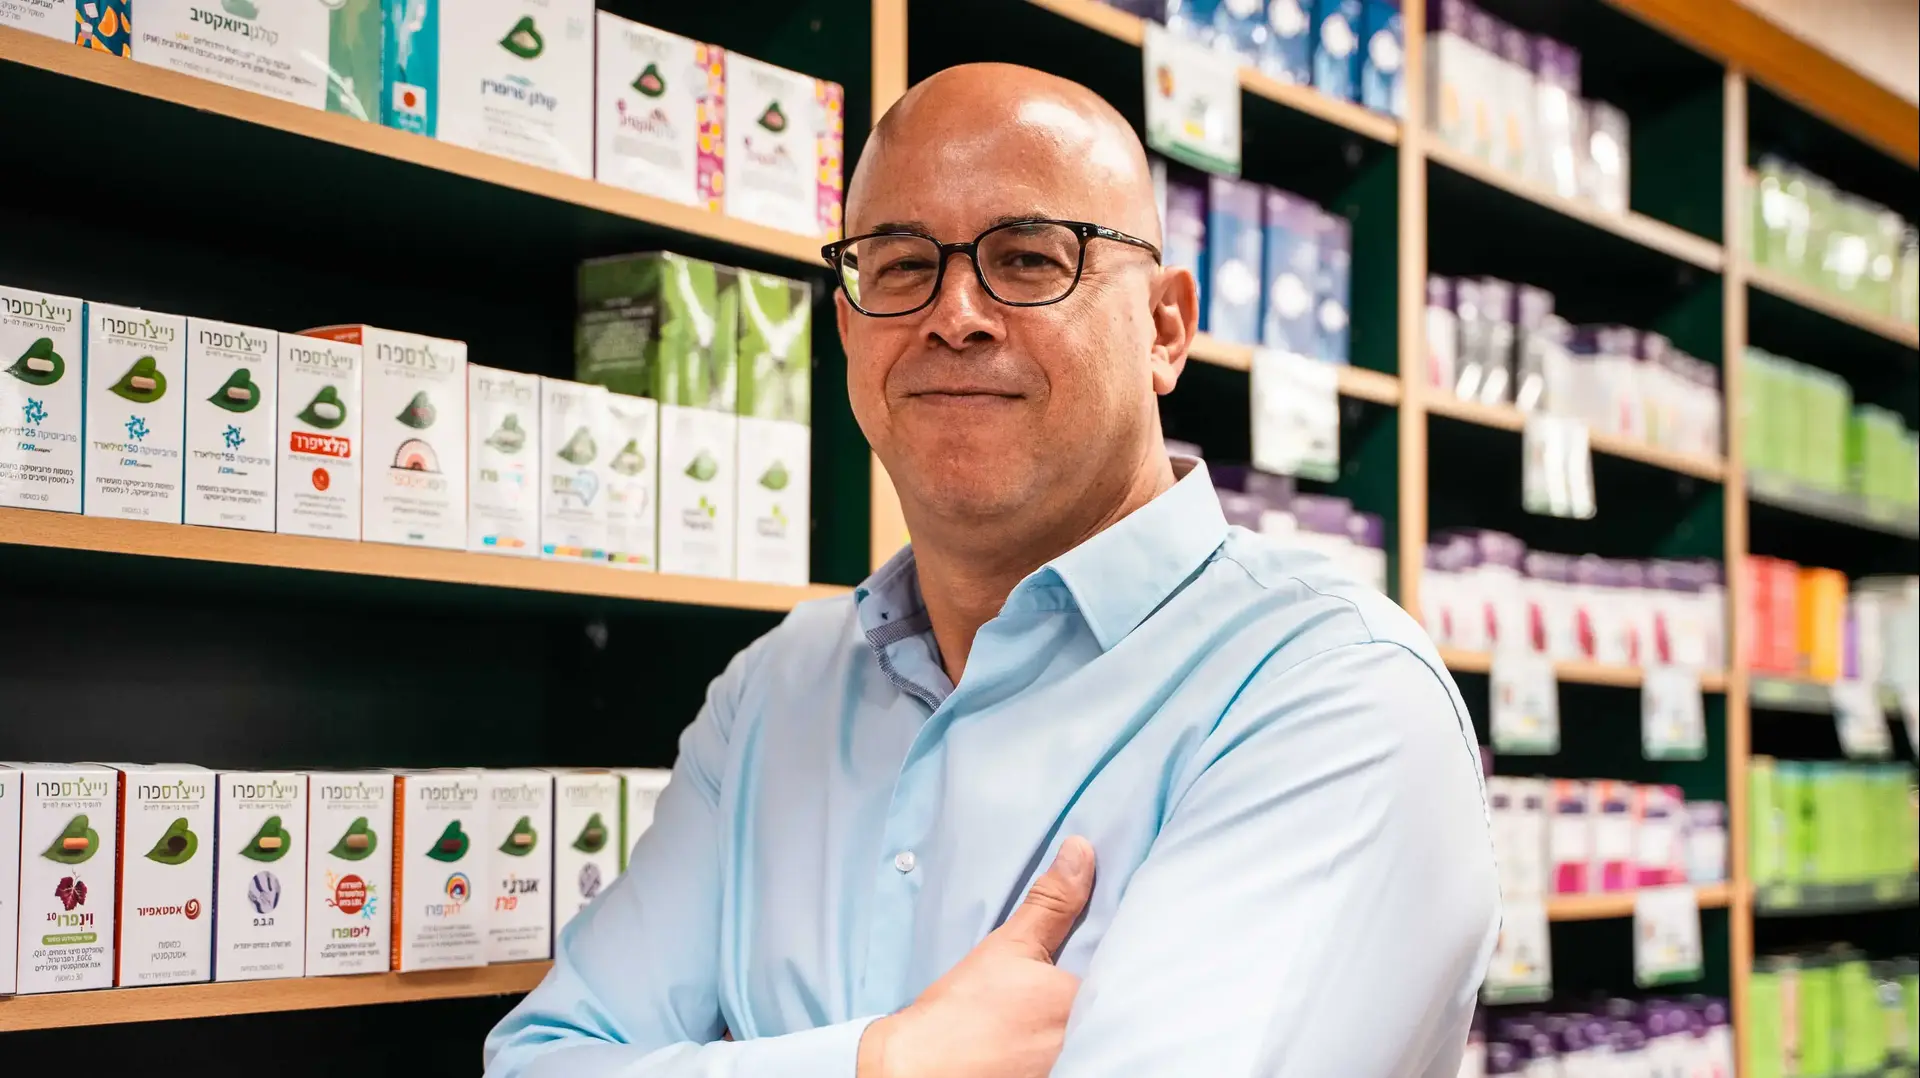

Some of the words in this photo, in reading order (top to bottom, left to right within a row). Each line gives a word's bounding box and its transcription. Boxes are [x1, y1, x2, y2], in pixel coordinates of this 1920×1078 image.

[190, 7, 250, 36] ביואקטיב
[137, 906, 182, 917] אסטאפיור
[331, 925, 371, 940] ליפופרו
